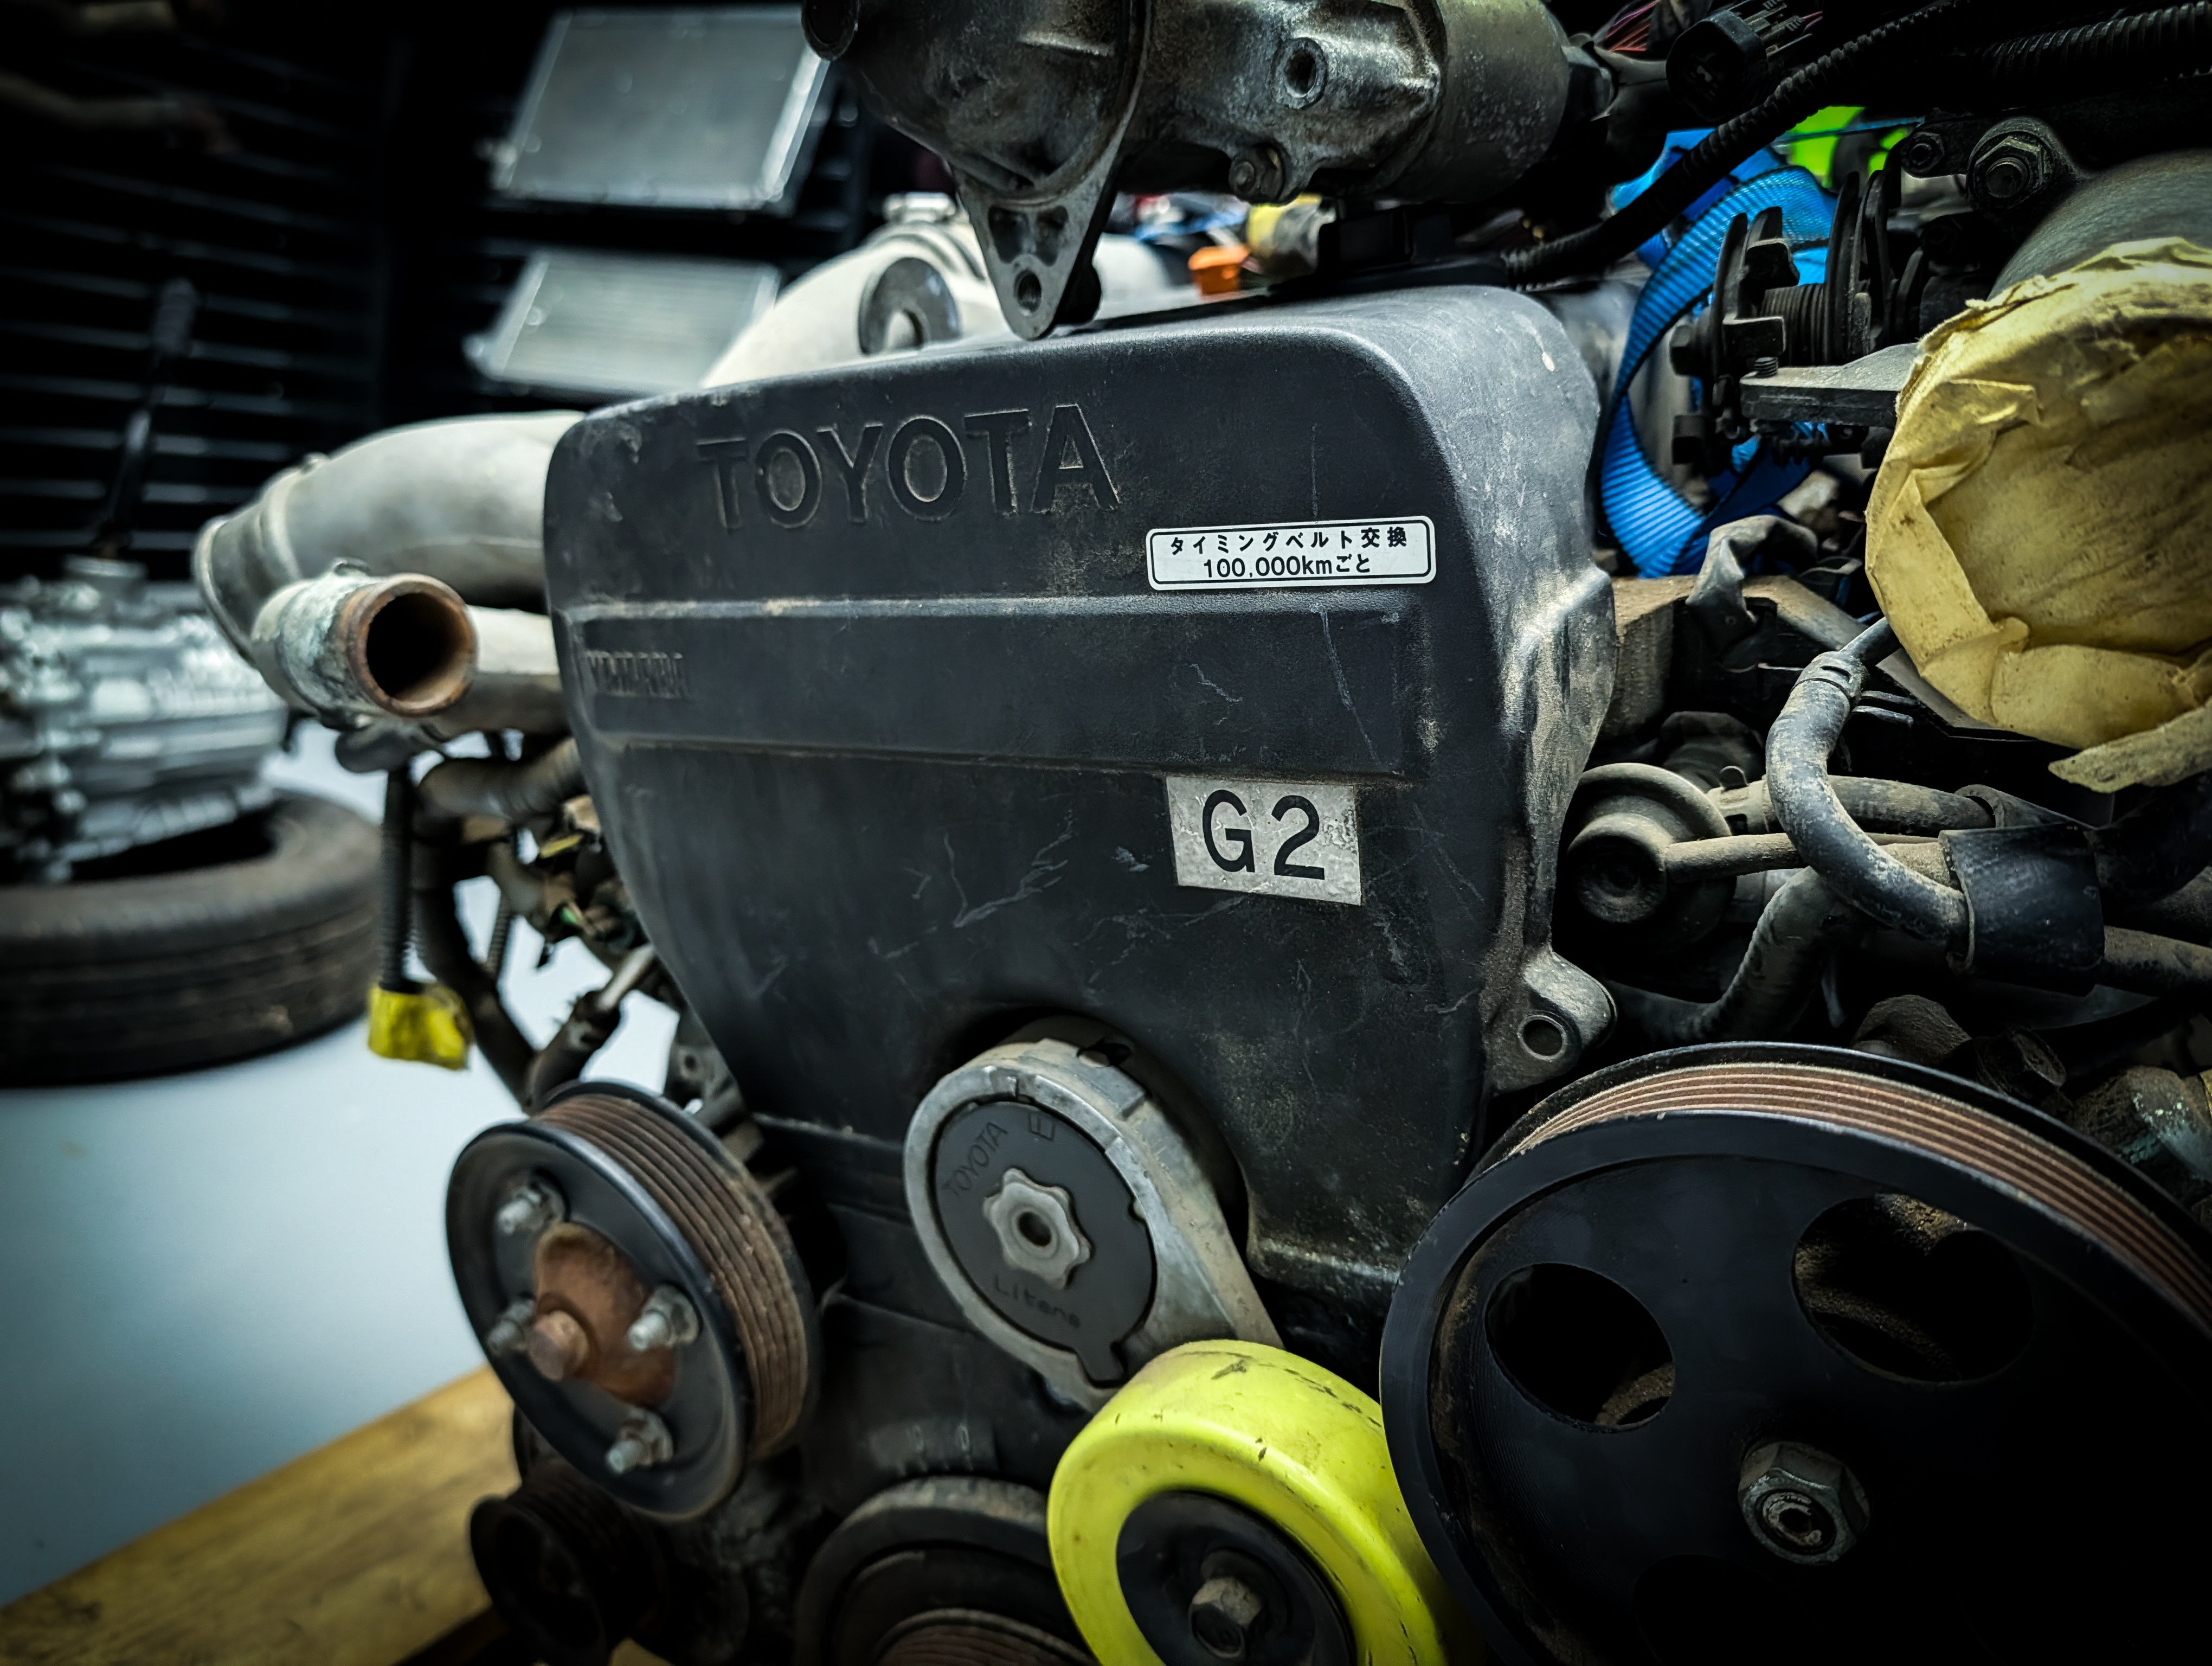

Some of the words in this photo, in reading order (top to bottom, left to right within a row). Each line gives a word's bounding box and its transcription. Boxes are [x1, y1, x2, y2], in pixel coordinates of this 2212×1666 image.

[696, 403, 1121, 534] TOYOTA
[1170, 527, 1407, 555] タイミングベルト交換
[1203, 554, 1371, 579] 100,000kmごと
[1202, 789, 1326, 880] G2
[942, 1121, 1009, 1198] TOYOTA
